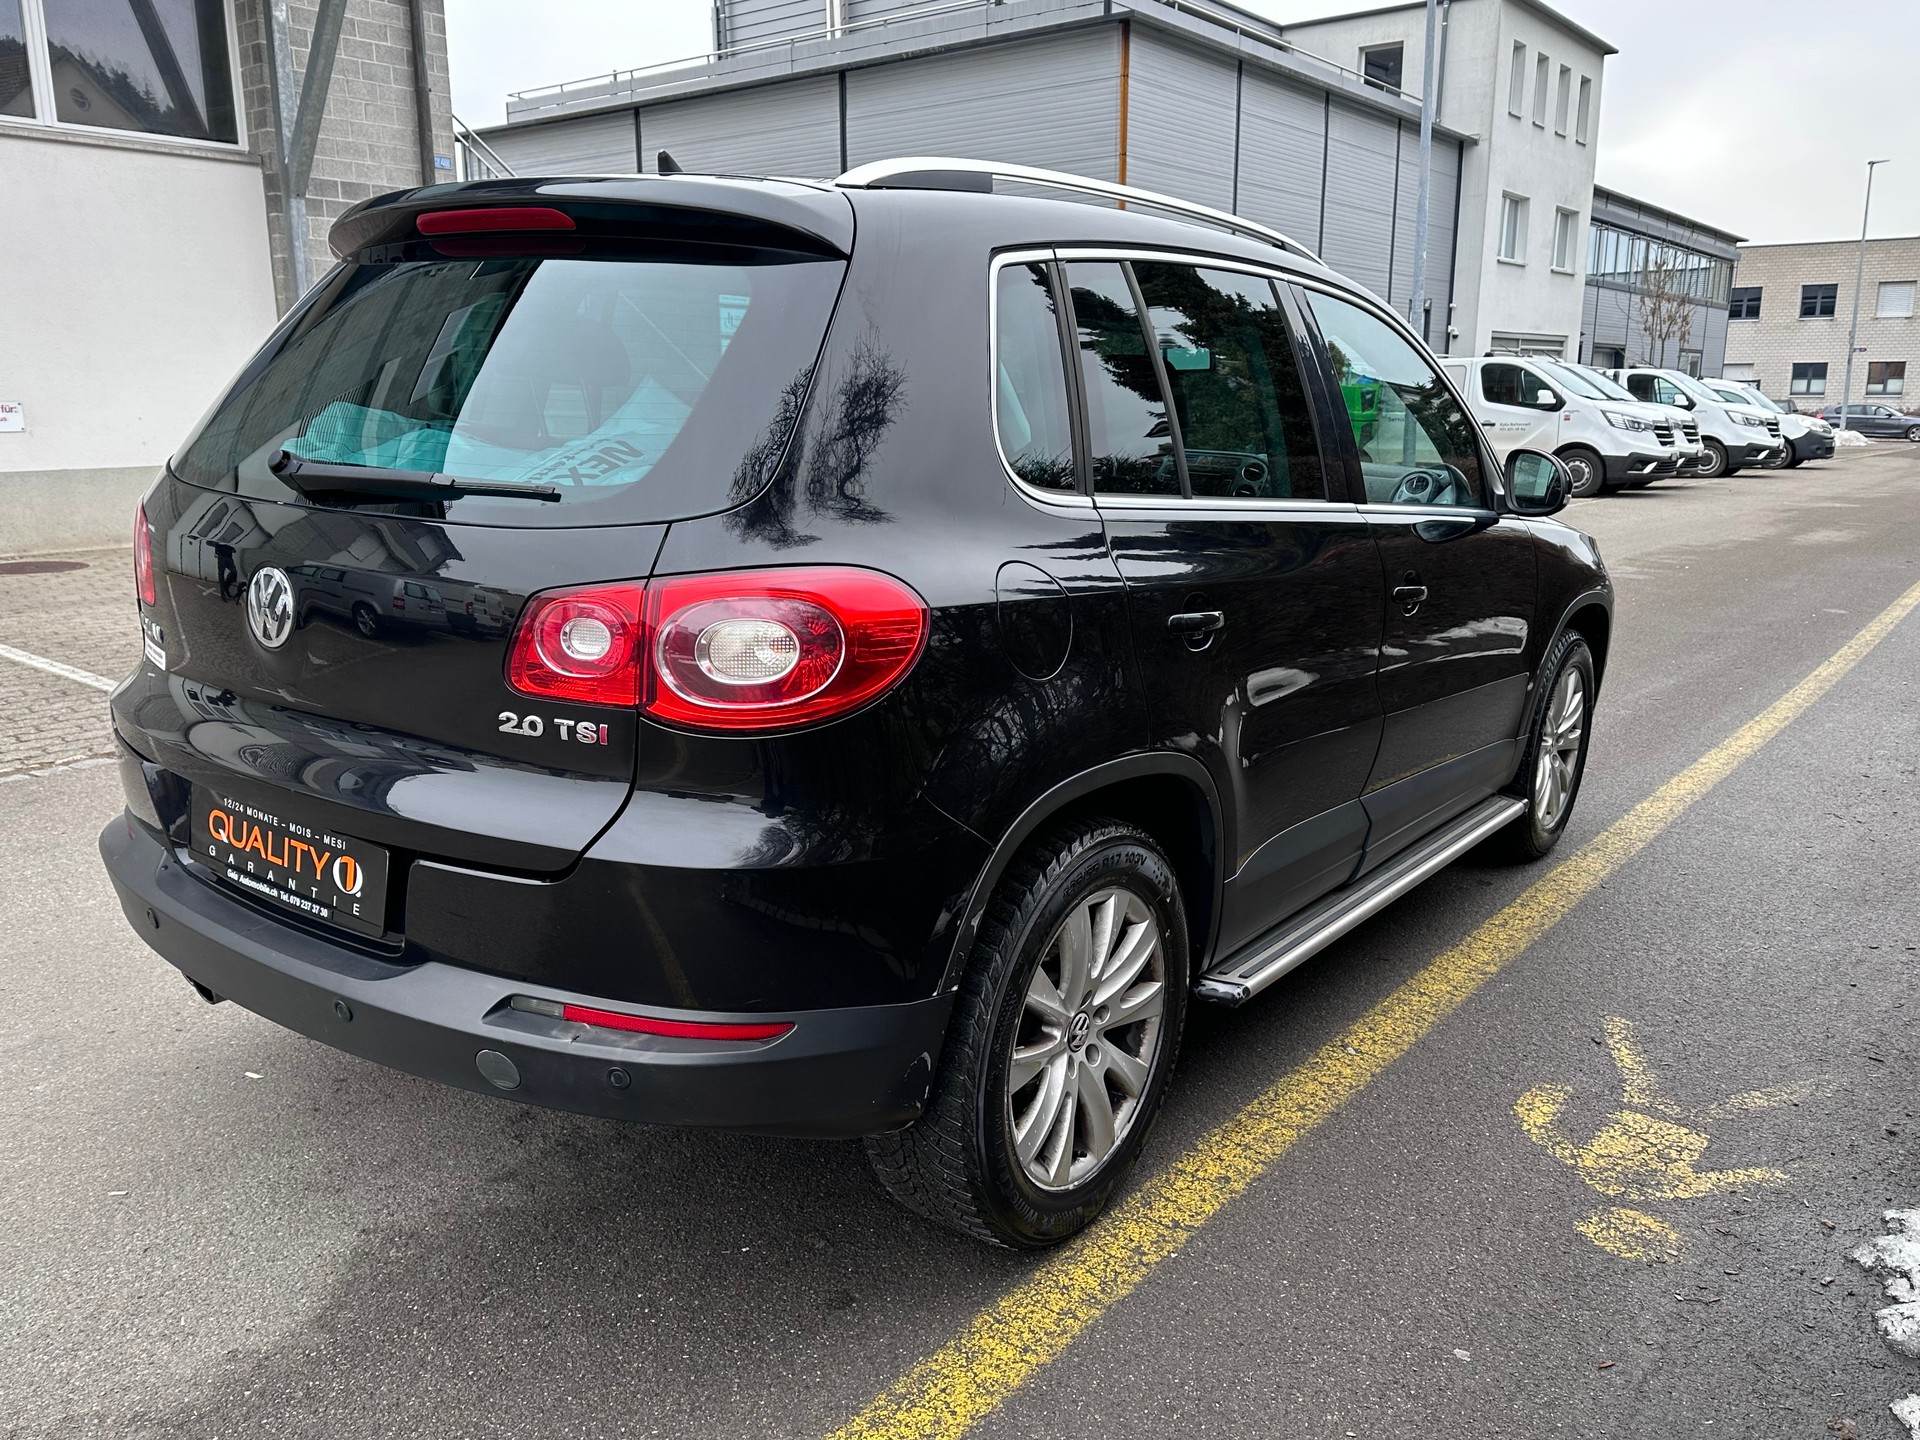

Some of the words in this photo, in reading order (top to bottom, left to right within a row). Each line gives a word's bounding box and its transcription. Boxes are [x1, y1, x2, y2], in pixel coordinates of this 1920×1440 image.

[553, 718, 608, 745] TSI
[223, 798, 244, 813] 12/24
[246, 806, 279, 827] MONATE
[289, 822, 312, 839] MOIS
[323, 834, 346, 850] MESI
[208, 809, 330, 880] QUALITY
[301, 900, 312, 911] 237
